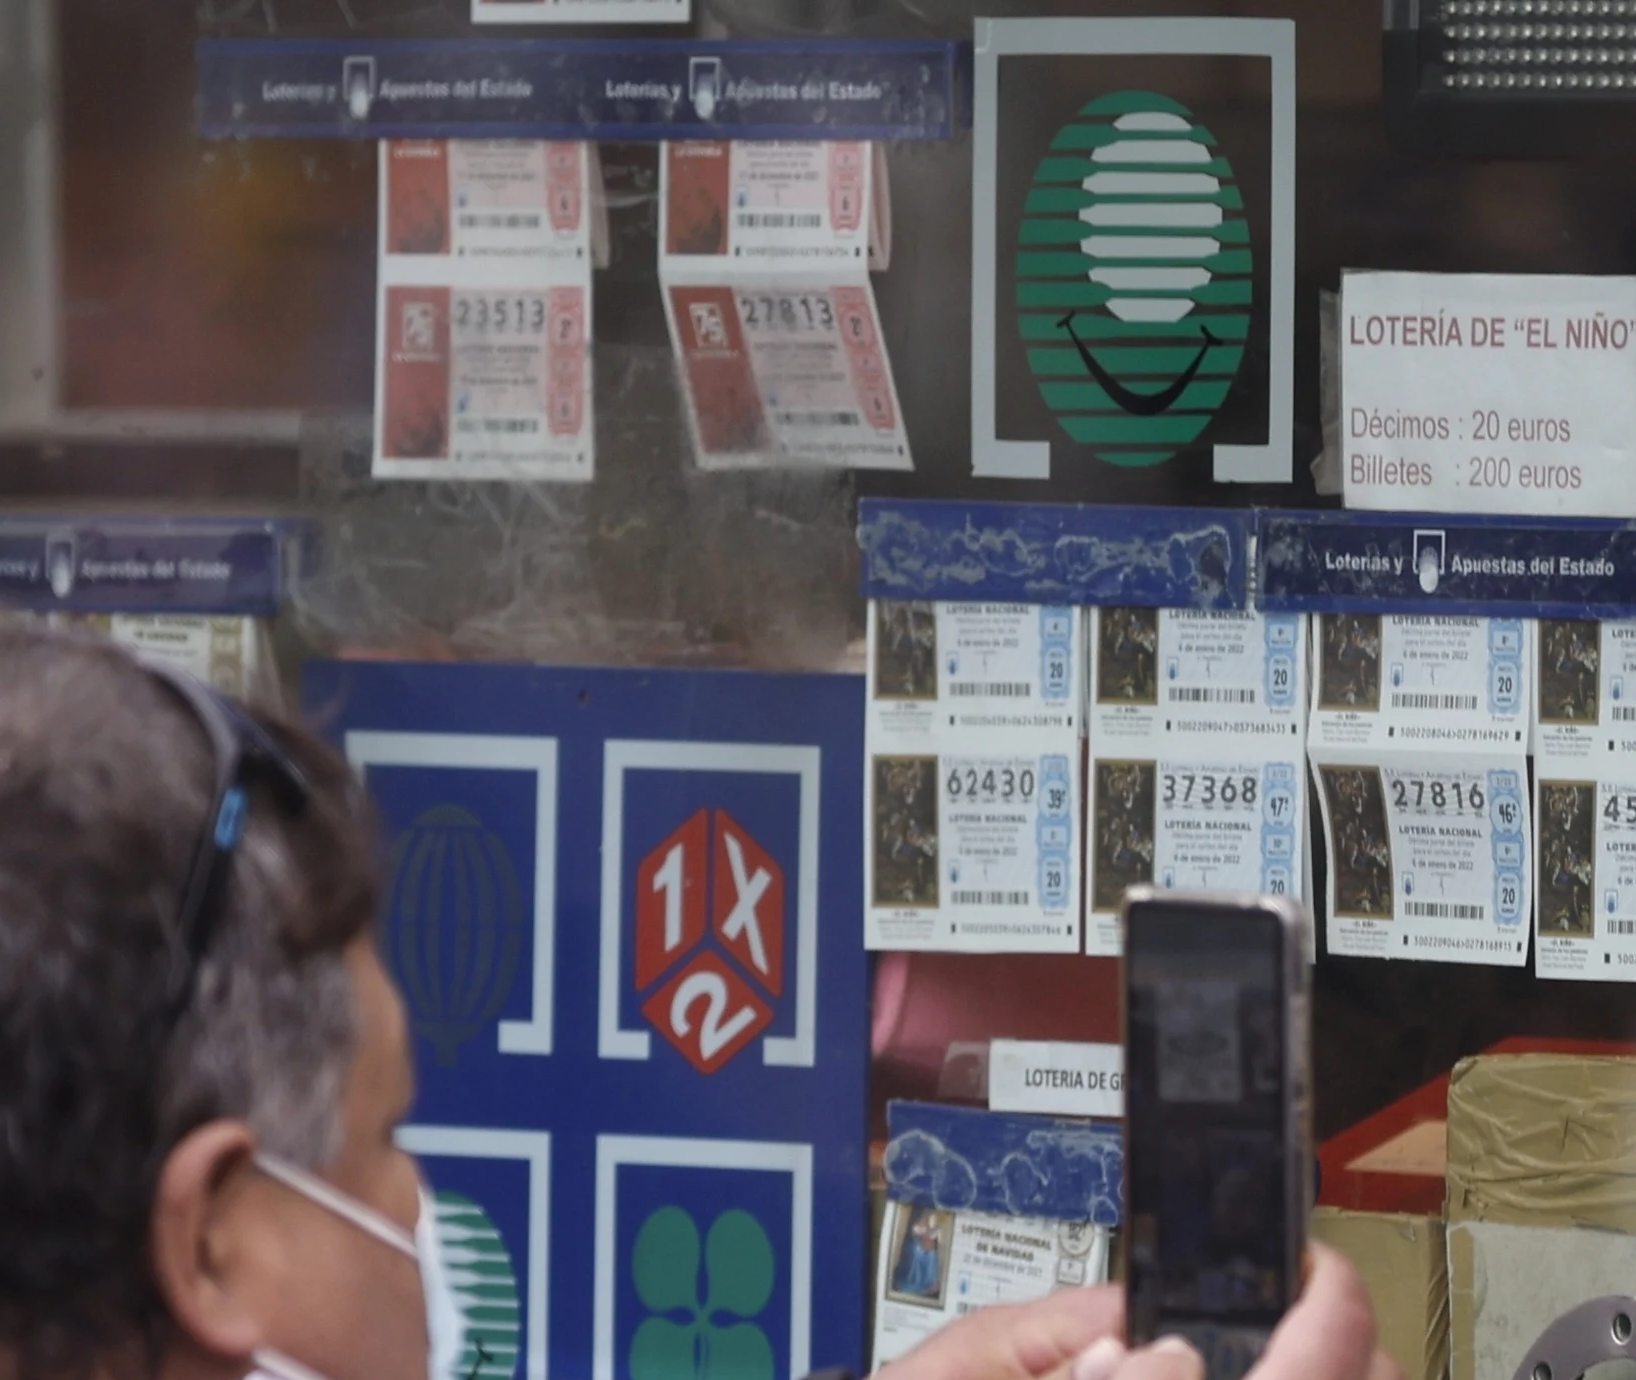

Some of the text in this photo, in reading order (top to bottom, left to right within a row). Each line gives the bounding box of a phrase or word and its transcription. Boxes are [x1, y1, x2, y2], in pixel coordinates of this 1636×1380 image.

[1350, 308, 1463, 346] LOTERÍA
[1470, 317, 1505, 348] DE
[1350, 408, 1450, 440] Décimos
[1471, 410, 1501, 441] 20
[1507, 416, 1572, 442] euros
[1350, 454, 1433, 487] Billetes
[1468, 456, 1511, 487] 200
[1518, 465, 1582, 489] euros
[1325, 552, 1615, 577] Loterías y Apuestas del Estado
[1274, 669, 1289, 687] 20
[1497, 677, 1513, 694] 20
[947, 768, 1035, 798] 62430
[1162, 774, 1258, 805] 37368
[1392, 779, 1486, 811] 27816
[1502, 887, 1515, 905] 20
[1024, 1067, 1084, 1089] LOTERIA
[1087, 1071, 1107, 1090] DE
